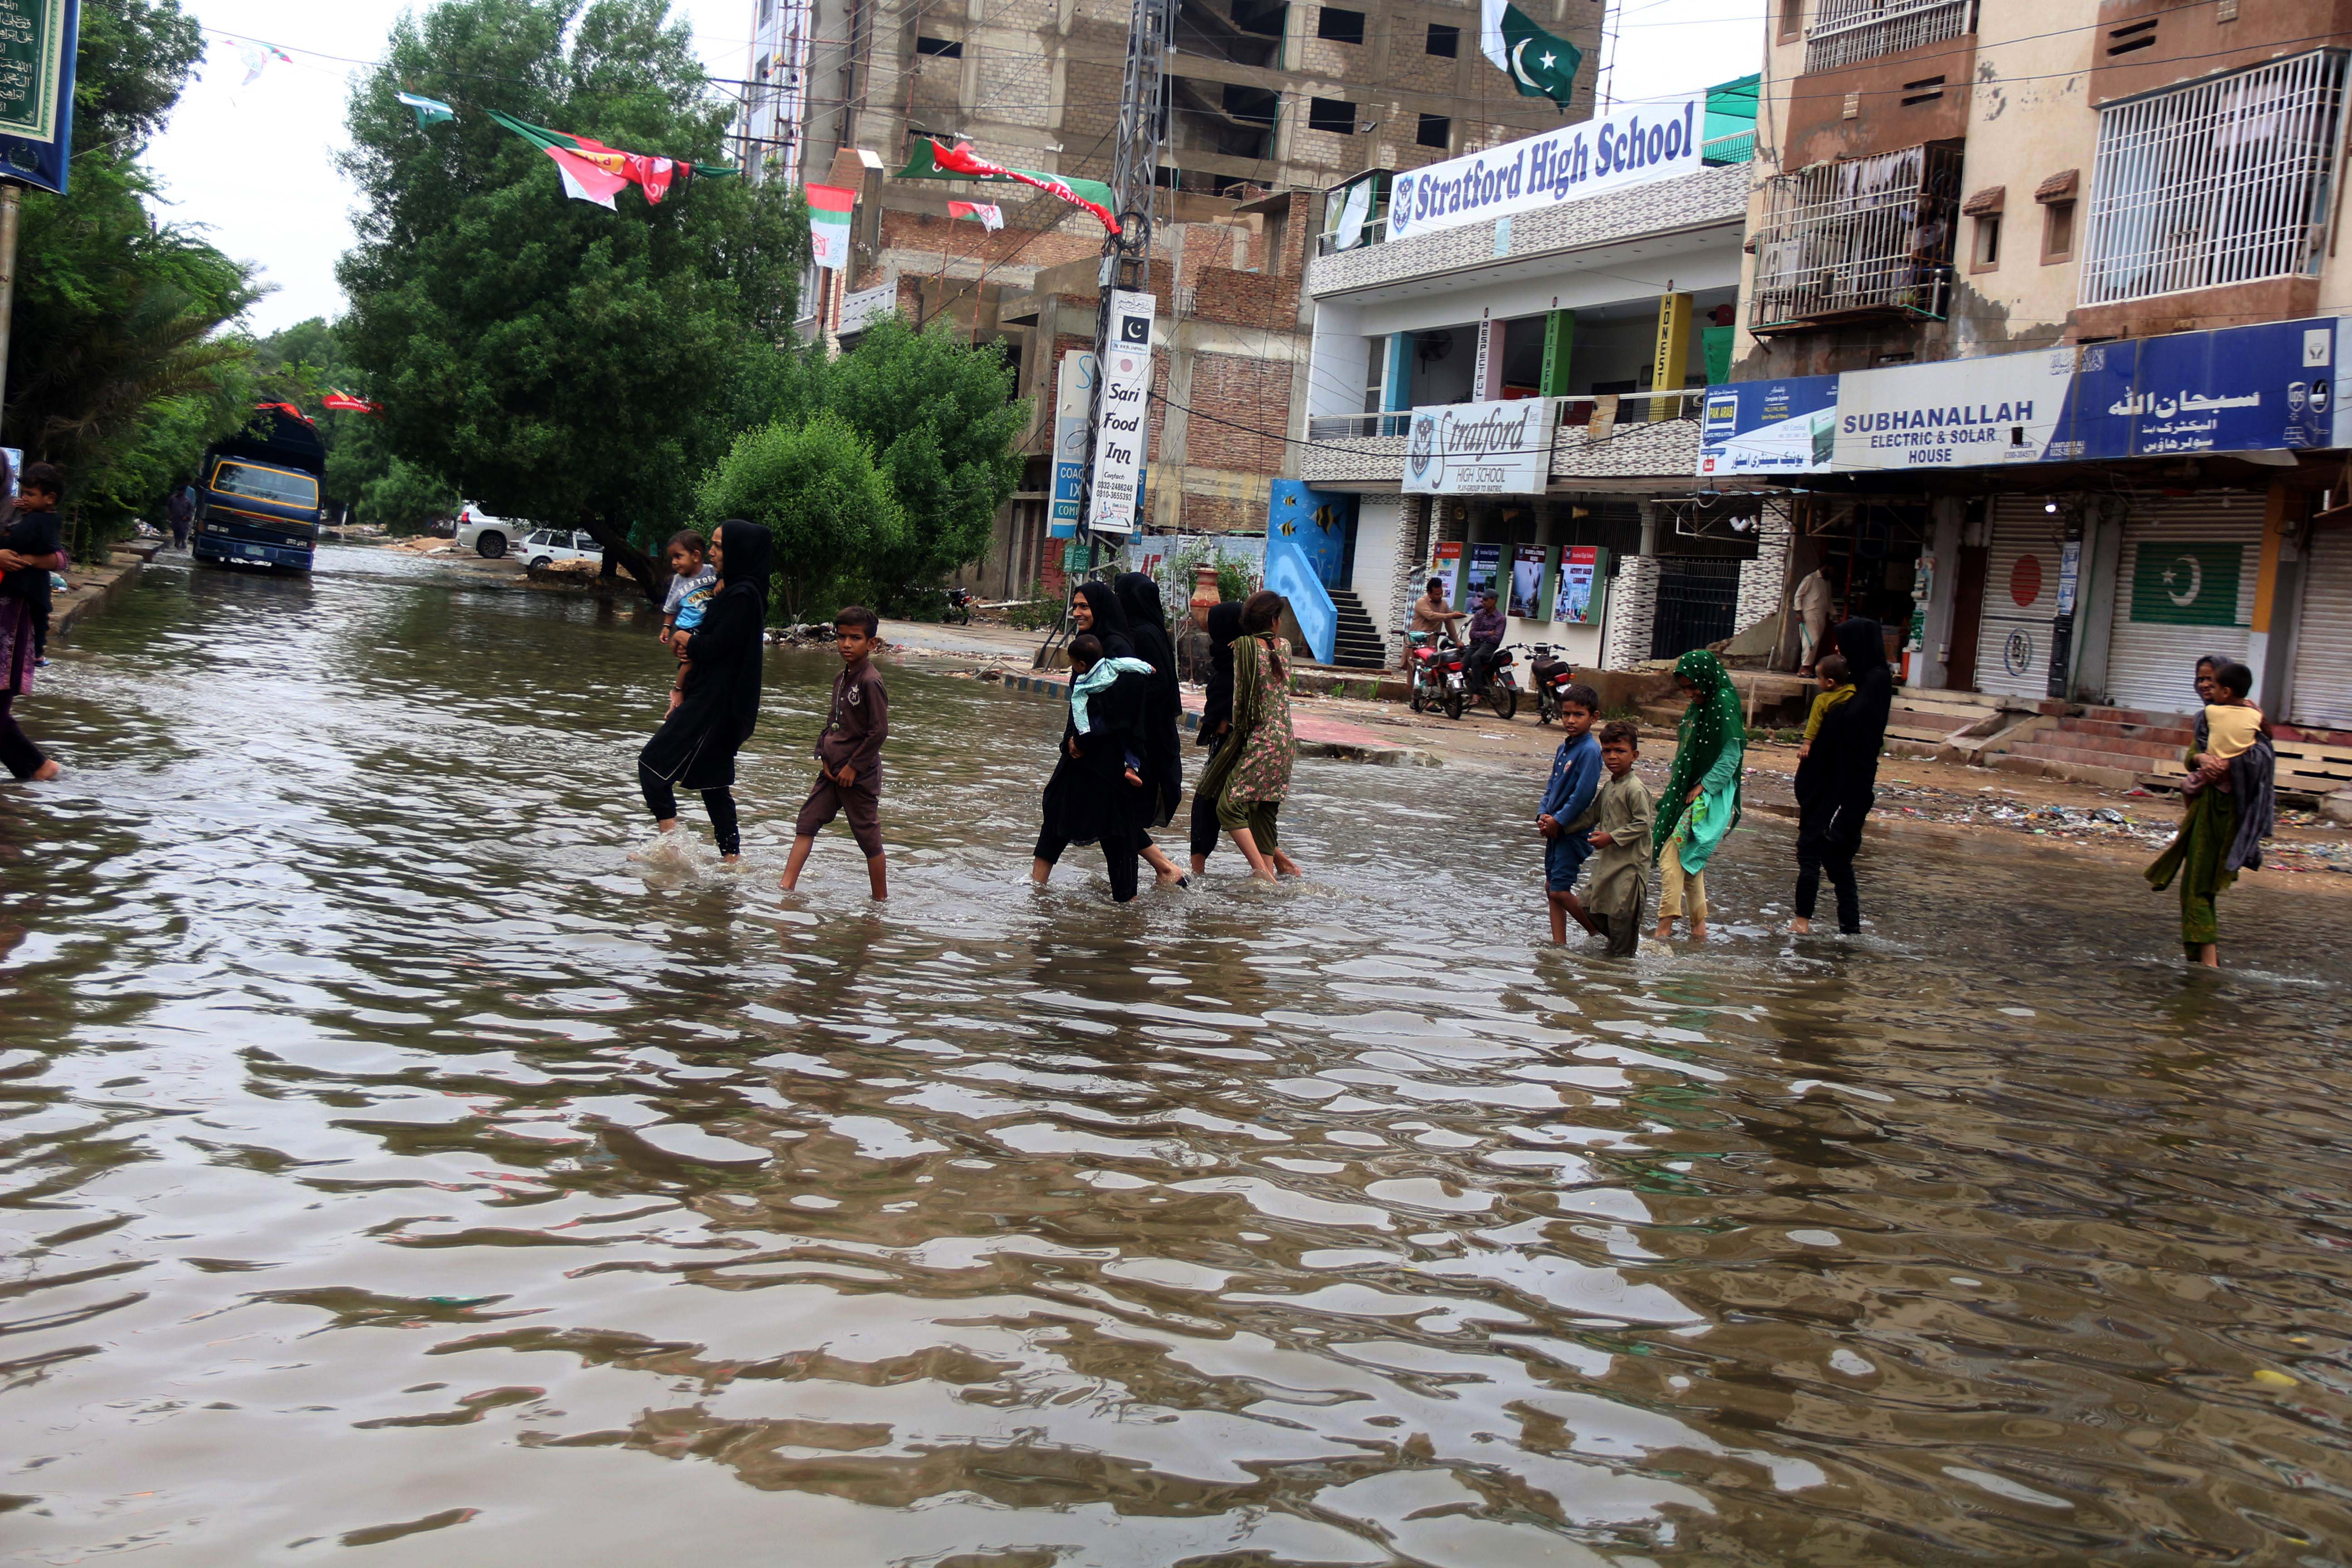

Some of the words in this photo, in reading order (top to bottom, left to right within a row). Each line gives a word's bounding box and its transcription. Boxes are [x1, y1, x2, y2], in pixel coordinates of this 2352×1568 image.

[1415, 148, 1524, 221] Stratford
[1526, 131, 1588, 200] High
[1594, 100, 1695, 177] School
[1657, 295, 1671, 386] HONEST
[1475, 321, 1489, 397] RESPECTFUL
[1544, 312, 1555, 396] FAITHFU
[1108, 383, 1141, 402] Sari
[1103, 412, 1140, 432] Food
[1709, 407, 1720, 418] PAK
[1720, 406, 1734, 418] ARAB
[1843, 400, 2033, 434] SUBHANALLAH
[1431, 405, 1530, 489] Stratford
[1870, 431, 1932, 449] ELECTRIC
[1936, 431, 1945, 445] &
[1950, 427, 1995, 444] SOLAR
[1105, 442, 1132, 465] Inn
[1908, 448, 1951, 464] HOUSE
[1456, 467, 1475, 482] HIGH
[1476, 467, 1505, 483] SCHOOL
[1096, 489, 1132, 501] 0310-3655393
[1097, 480, 1133, 492] 0332-2486248
[678, 580, 695, 596] NEW
[696, 575, 717, 585] YORK
